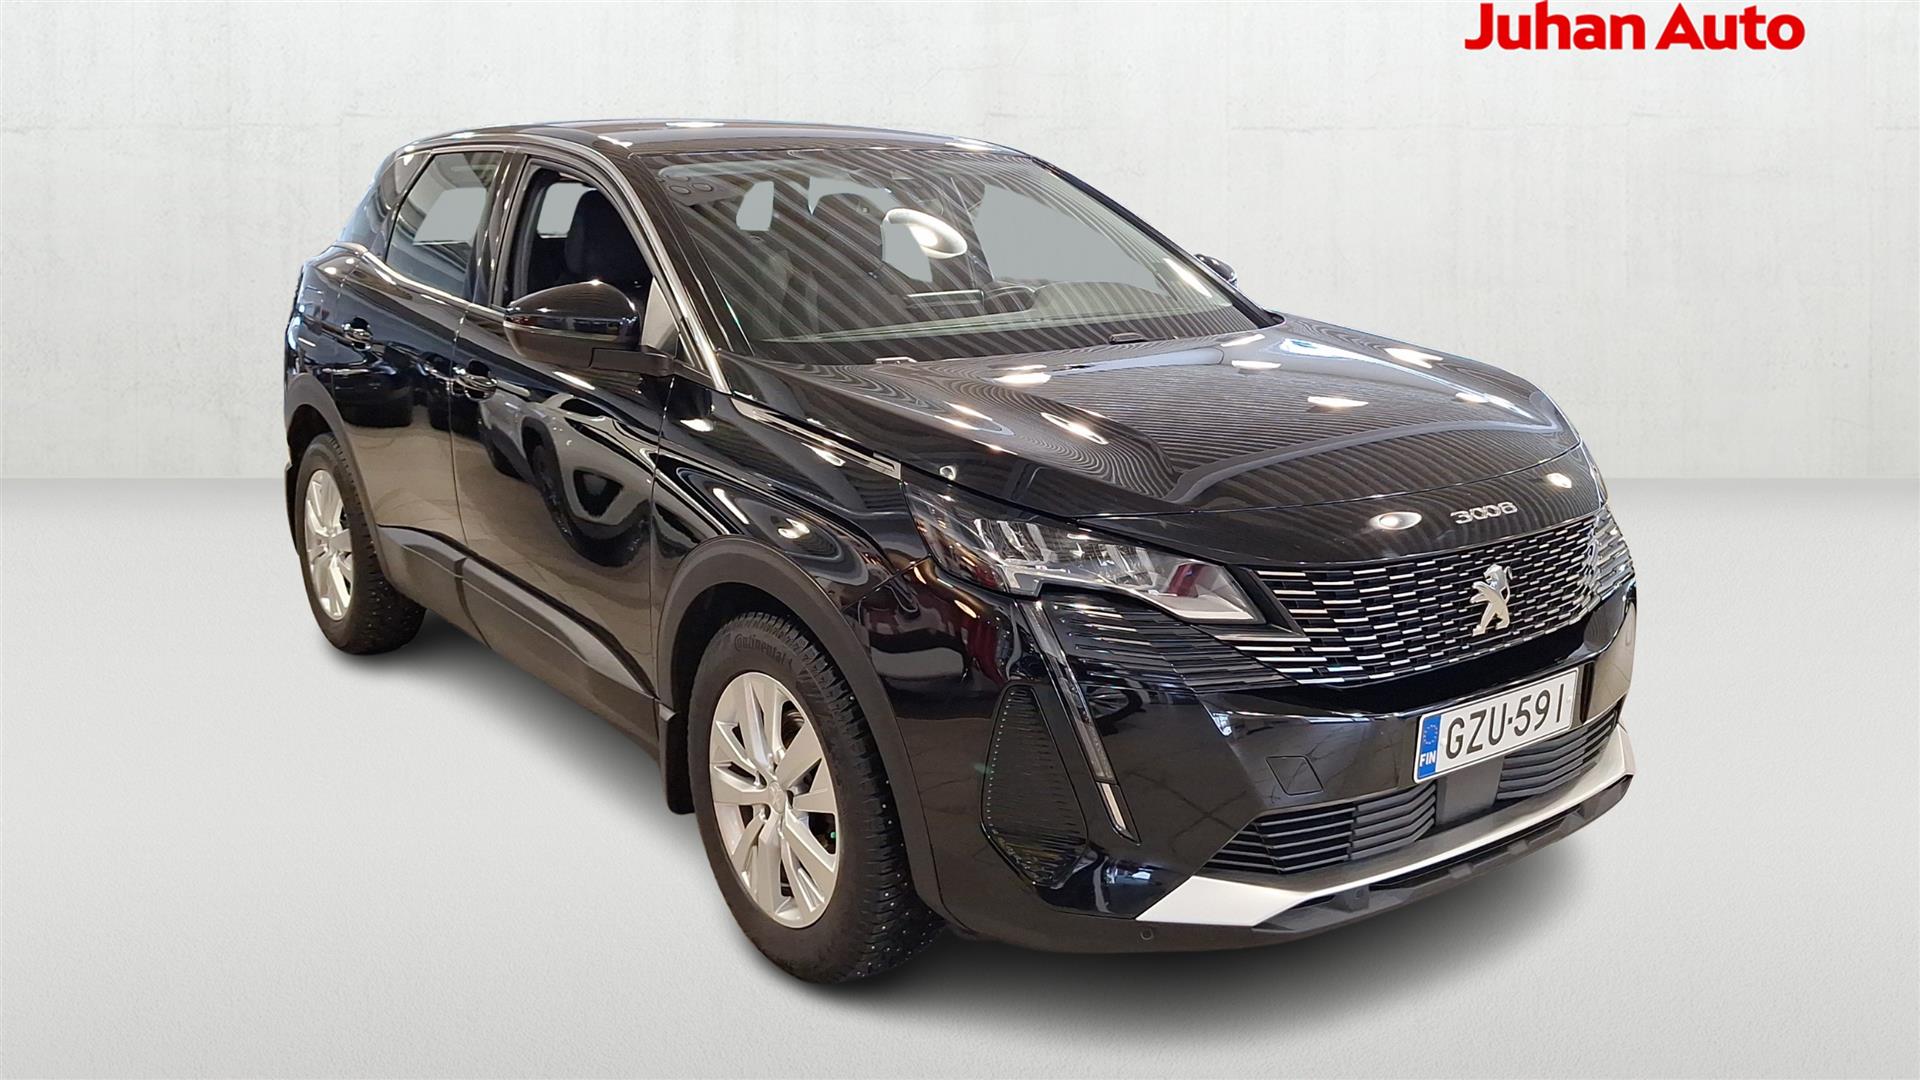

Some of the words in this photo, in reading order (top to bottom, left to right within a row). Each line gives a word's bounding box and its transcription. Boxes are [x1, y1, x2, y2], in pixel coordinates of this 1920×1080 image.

[1450, 501, 1518, 524] 3008
[1445, 683, 1565, 760] GZU-591
[1419, 750, 1437, 768] FIN
